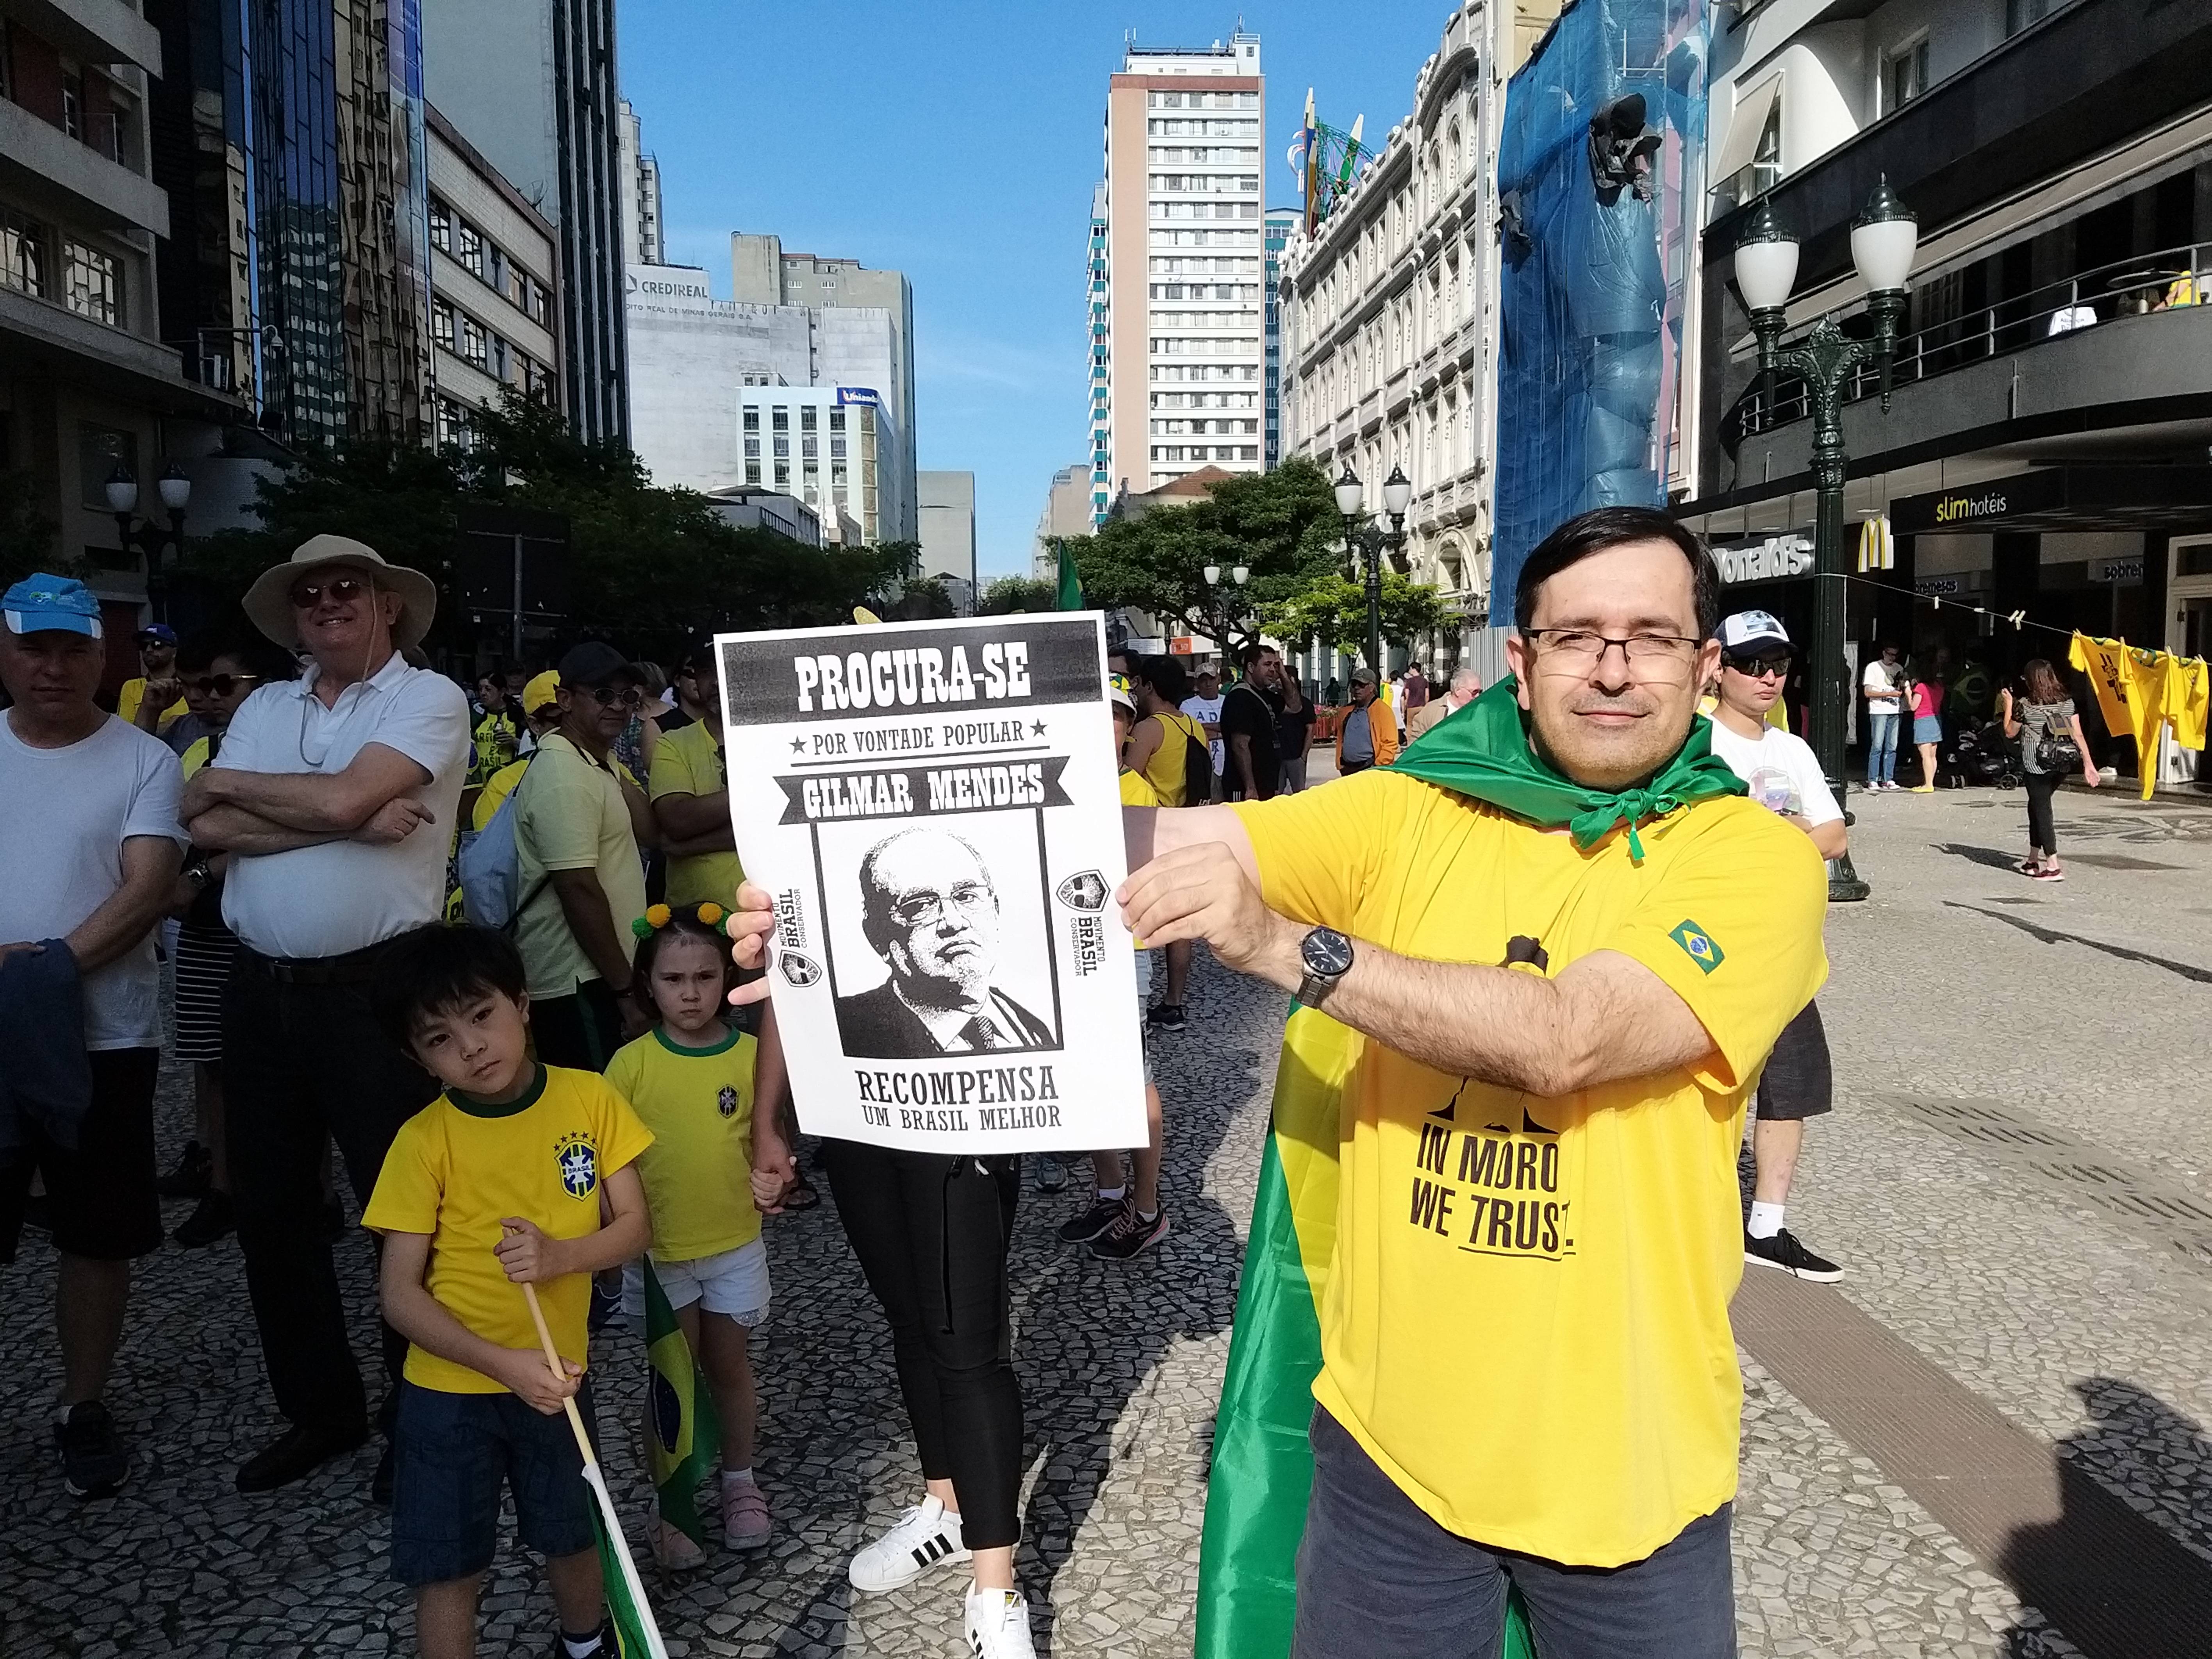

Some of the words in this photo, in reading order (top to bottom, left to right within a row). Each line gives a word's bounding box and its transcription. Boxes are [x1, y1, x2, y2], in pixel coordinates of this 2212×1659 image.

[642, 281, 708, 298] CREDIREAL
[1712, 534, 1811, 583] onald's
[794, 641, 1031, 712] PROCURA-SE
[813, 734, 847, 755] POR
[853, 727, 934, 753] VONTADE
[943, 721, 1024, 747] POPULAR
[802, 773, 913, 818] GILMAR
[927, 763, 1045, 811] MENDES
[780, 888, 800, 948] BRASIL
[794, 888, 807, 948] CONSERVADOR
[1094, 916, 1105, 962] MOVIMENTO
[1070, 917, 1081, 976] CONSERVADOR
[1078, 916, 1097, 976] BRASIL
[854, 1066, 1058, 1105] RECOMPENSA
[862, 1105, 891, 1127] UM
[899, 1108, 968, 1131] BRASIL
[979, 1105, 1061, 1130] MELHOR
[568, 1165, 592, 1174] BRASIL
[1416, 1122, 1452, 1176] IN
[1457, 1135, 1559, 1193] MORO
[1410, 1176, 1456, 1237] WE
[1468, 1194, 1574, 1253] TRUS.
